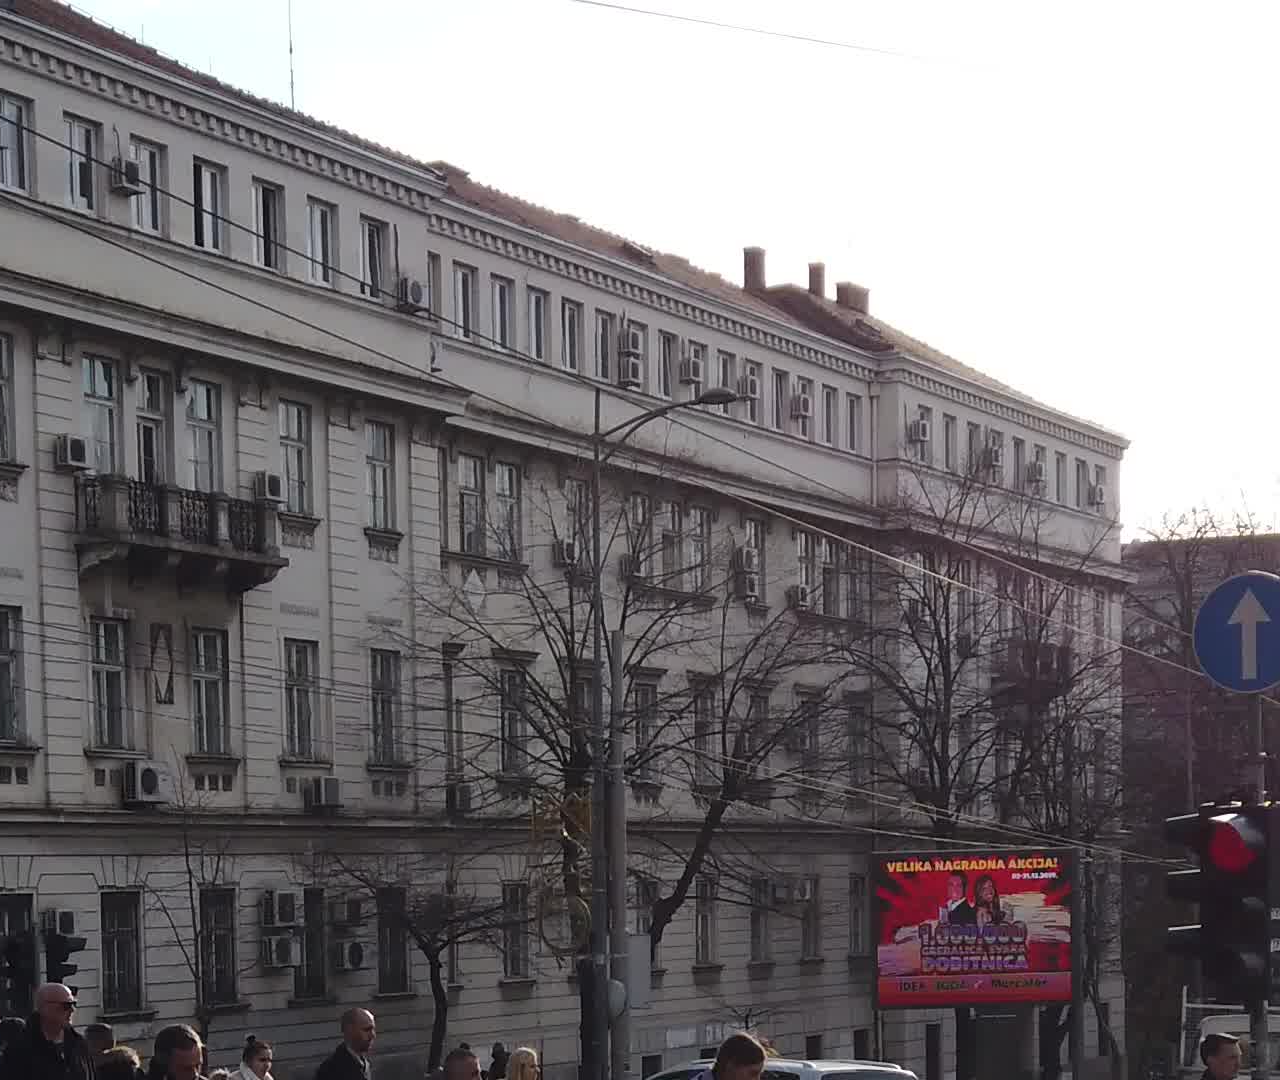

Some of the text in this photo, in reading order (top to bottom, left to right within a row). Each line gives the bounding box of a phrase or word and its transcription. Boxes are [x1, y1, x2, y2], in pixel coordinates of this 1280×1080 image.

[887, 857, 1058, 873] VELIKA NAGRADNA AKCIJA!
